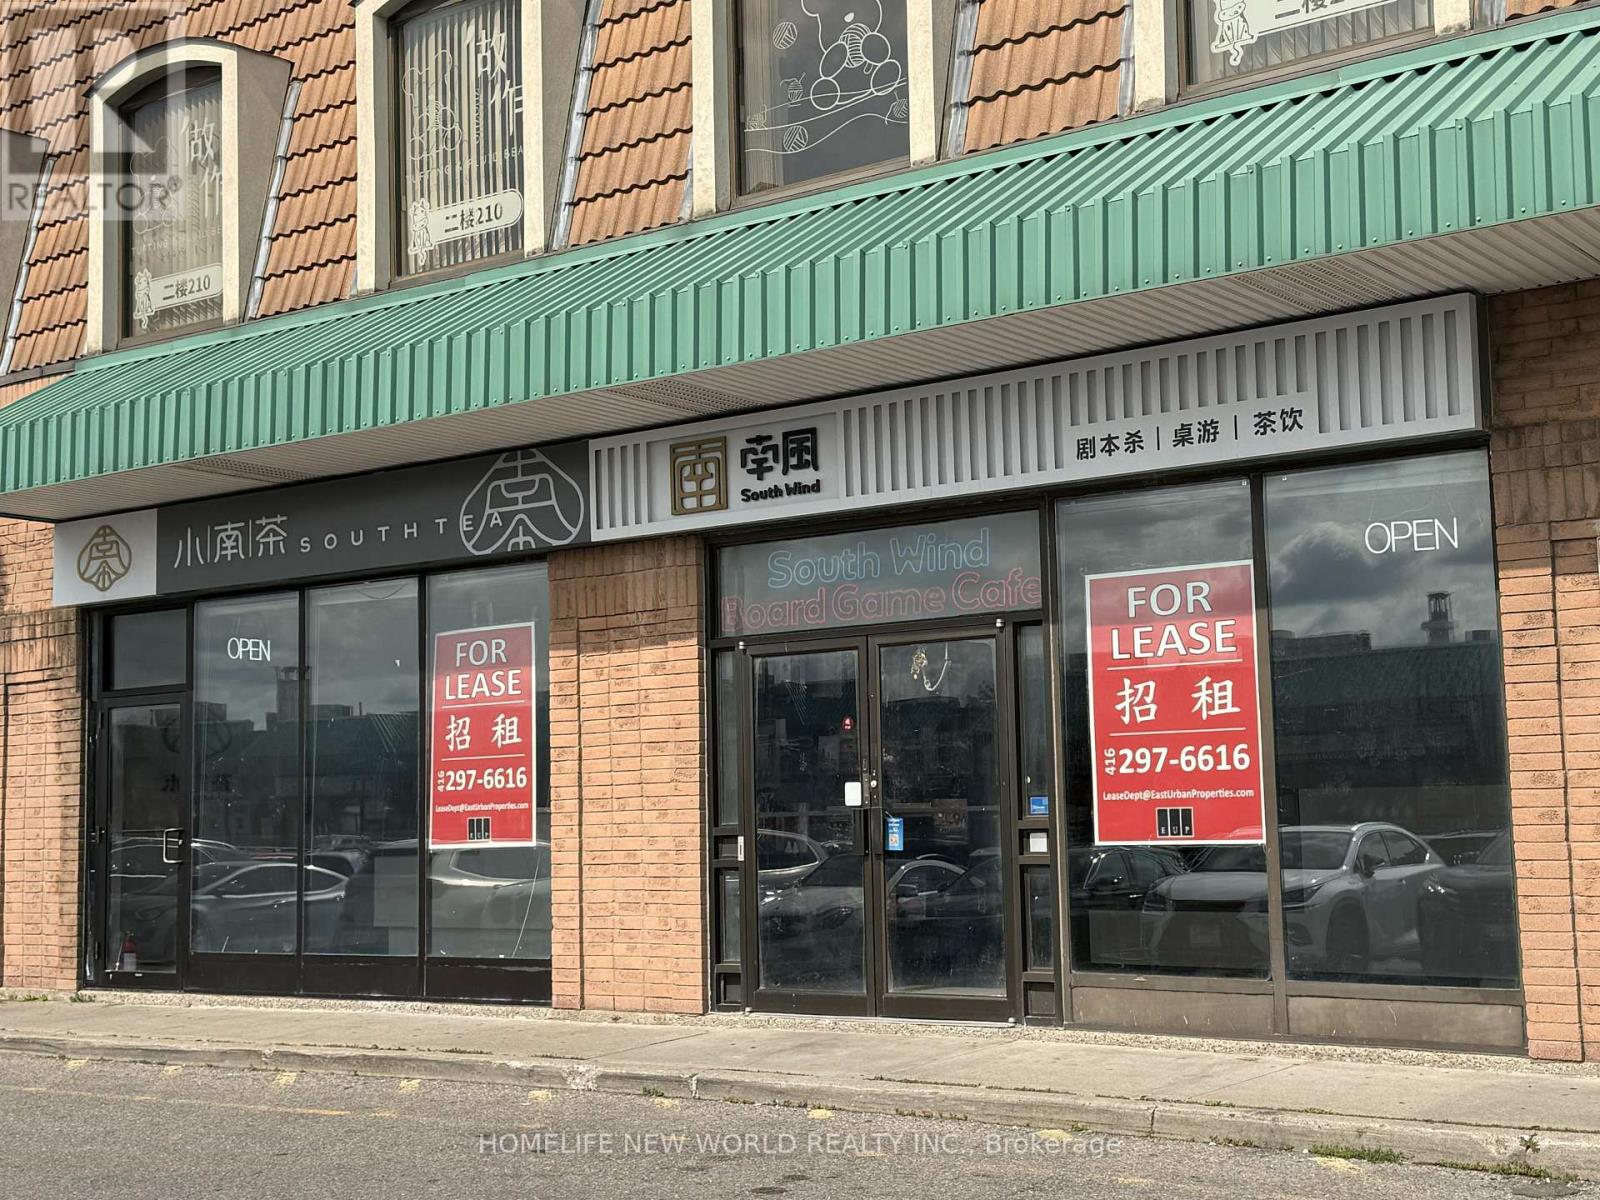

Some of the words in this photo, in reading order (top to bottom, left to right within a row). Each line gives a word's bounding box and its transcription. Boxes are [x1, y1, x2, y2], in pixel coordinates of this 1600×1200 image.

[1076, 430, 1145, 461] 剧本杀
[1172, 419, 1220, 448] 桌游
[1253, 407, 1304, 437] 茶饮
[740, 484, 784, 503] South
[784, 479, 821, 497] Wind
[300, 521, 418, 553] SOUTH
[434, 512, 503, 535] TEA
[1364, 516, 1459, 554] OPEN
[767, 542, 880, 589] South
[889, 527, 990, 576] Wind
[721, 586, 827, 632] Board
[833, 583, 946, 621] Game
[1127, 580, 1213, 619] FOR
[227, 637, 271, 662] OPEN
[455, 638, 507, 668] FOR
[1111, 619, 1237, 660] LEASE
[445, 669, 522, 700] LEASE
[1104, 747, 1116, 776] 416
[1118, 743, 1251, 774] 297-6616
[445, 766, 527, 791] 297-6616
[1103, 787, 1254, 801] LeaseDept@EastUrbanProperties.com
